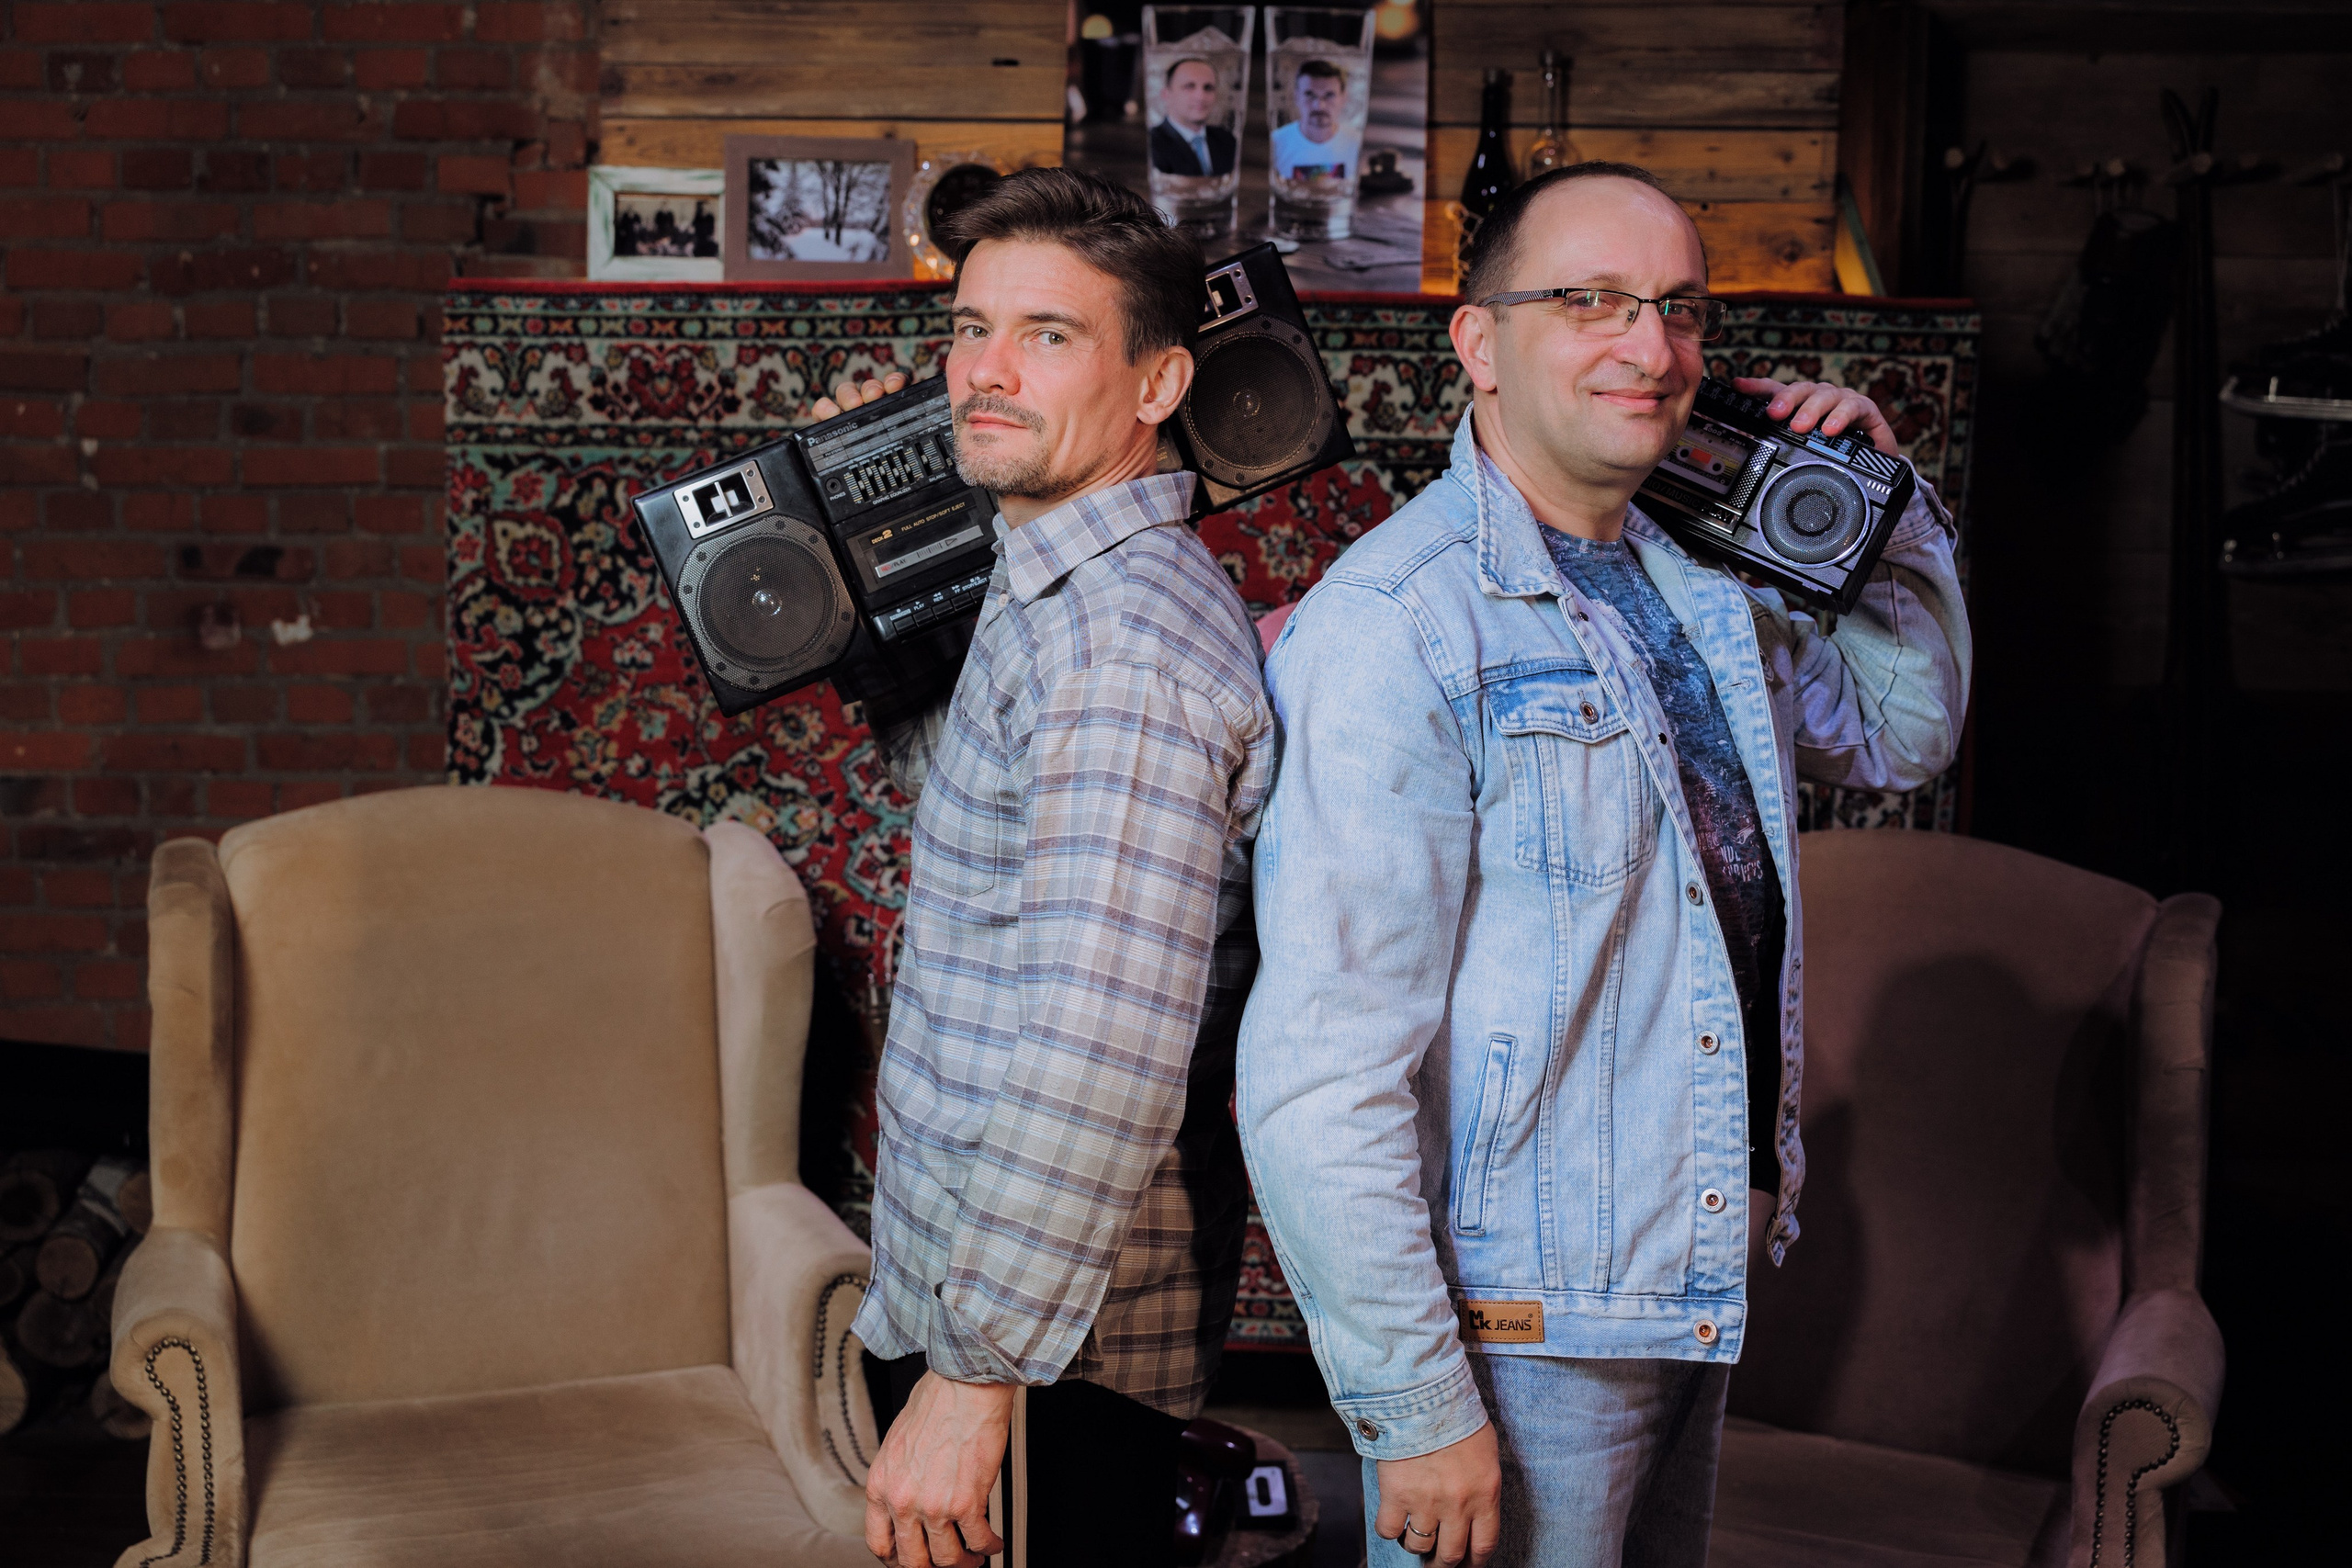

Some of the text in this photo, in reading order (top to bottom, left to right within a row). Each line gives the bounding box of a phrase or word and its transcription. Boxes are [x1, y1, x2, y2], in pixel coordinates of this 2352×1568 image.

[808, 423, 858, 446] Panasonic
[929, 472, 946, 482] BALANCE
[830, 492, 845, 501] PHONES
[873, 487, 911, 504] GRAPHIC EQUALIZER
[926, 509, 950, 521] STOP/SOFT
[951, 502, 966, 511] EJECT
[1495, 1318, 1532, 1331] JEANS
